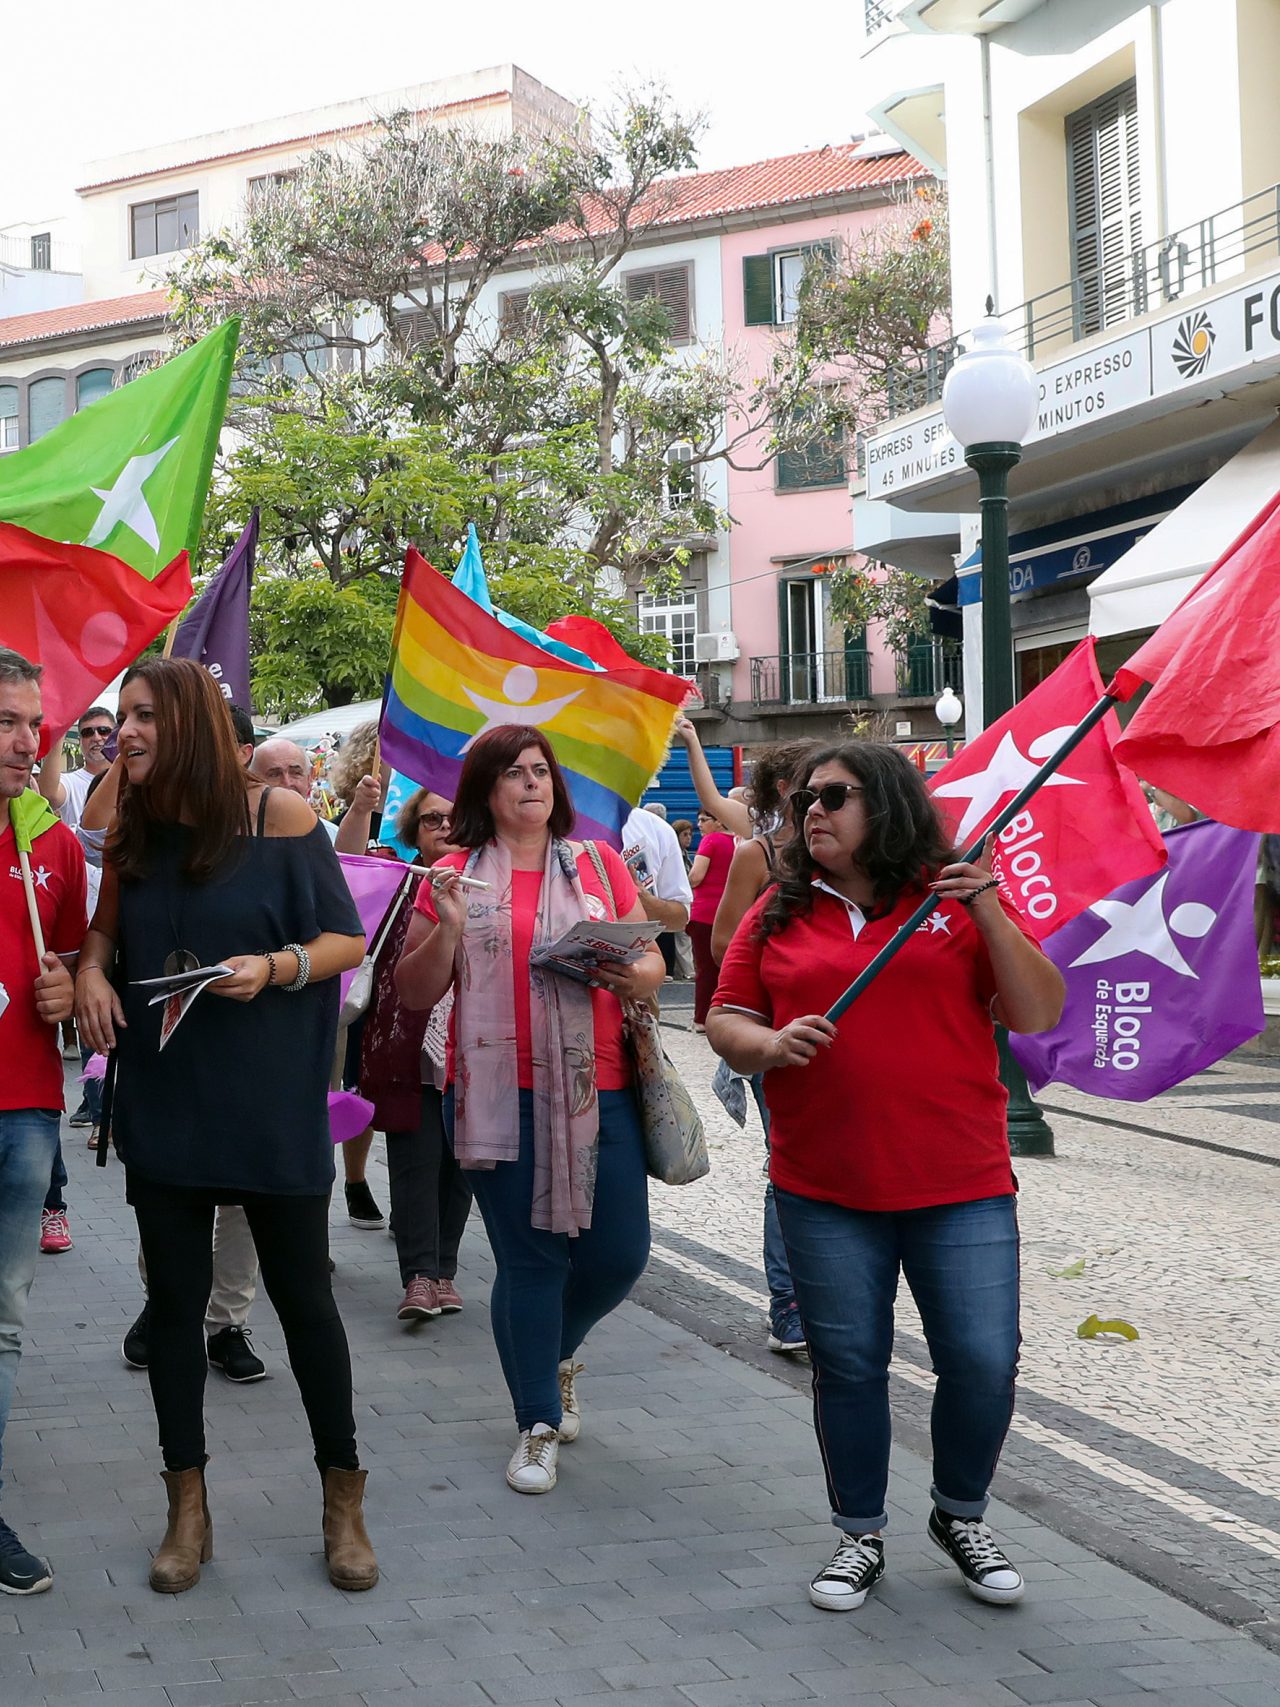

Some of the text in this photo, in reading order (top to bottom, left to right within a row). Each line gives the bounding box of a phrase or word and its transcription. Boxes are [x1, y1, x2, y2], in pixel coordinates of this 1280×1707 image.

[1055, 350, 1132, 395] EXPRESSO
[1039, 391, 1105, 431] MINUTOS
[870, 435, 913, 464] EXPRESS
[882, 447, 956, 487] 45 MINUTES
[999, 809, 1058, 919] Bloco
[591, 940, 628, 956] Bloco
[1090, 979, 1114, 1069] de Esquerda
[1111, 981, 1153, 1071] Bloco
